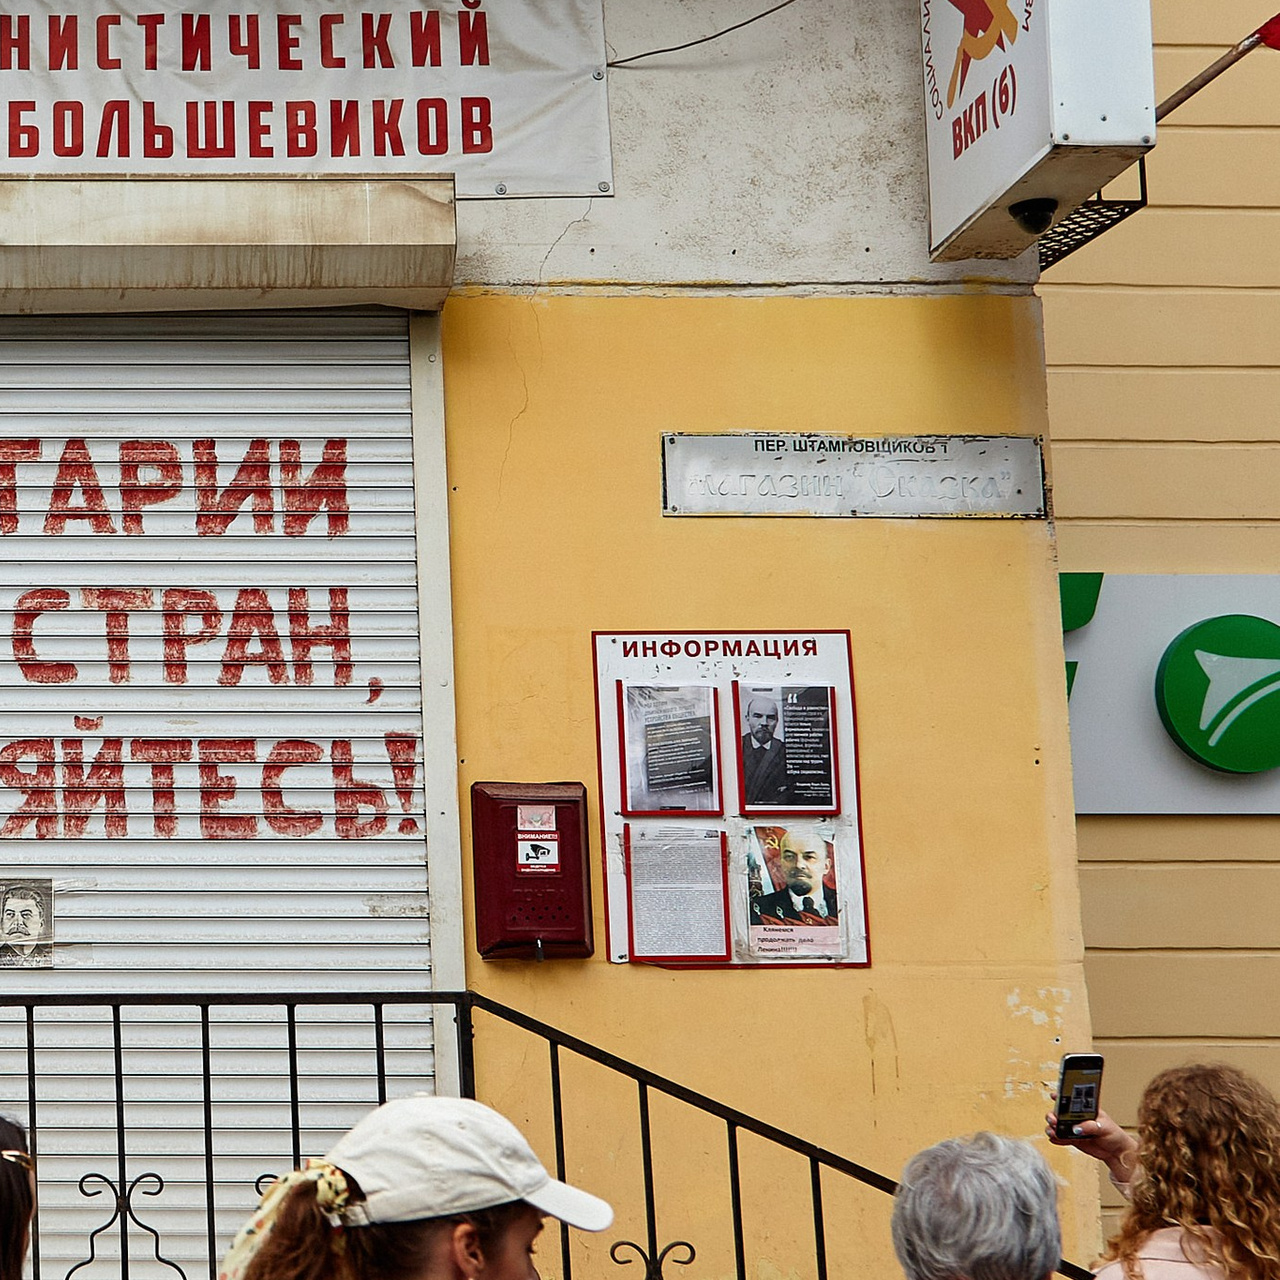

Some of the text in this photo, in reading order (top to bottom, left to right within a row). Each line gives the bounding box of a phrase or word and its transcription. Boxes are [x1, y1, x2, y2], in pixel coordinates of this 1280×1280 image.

[7, 96, 494, 159] БОЛЬШЕВИКОВ
[952, 90, 988, 161] ВКП
[754, 439, 788, 452] ПЕР.
[793, 439, 935, 455] ШТАМПОВЩИКОВ
[11, 587, 384, 704] СТРАН,
[622, 639, 818, 660] ИНФОРМАЦИЯ
